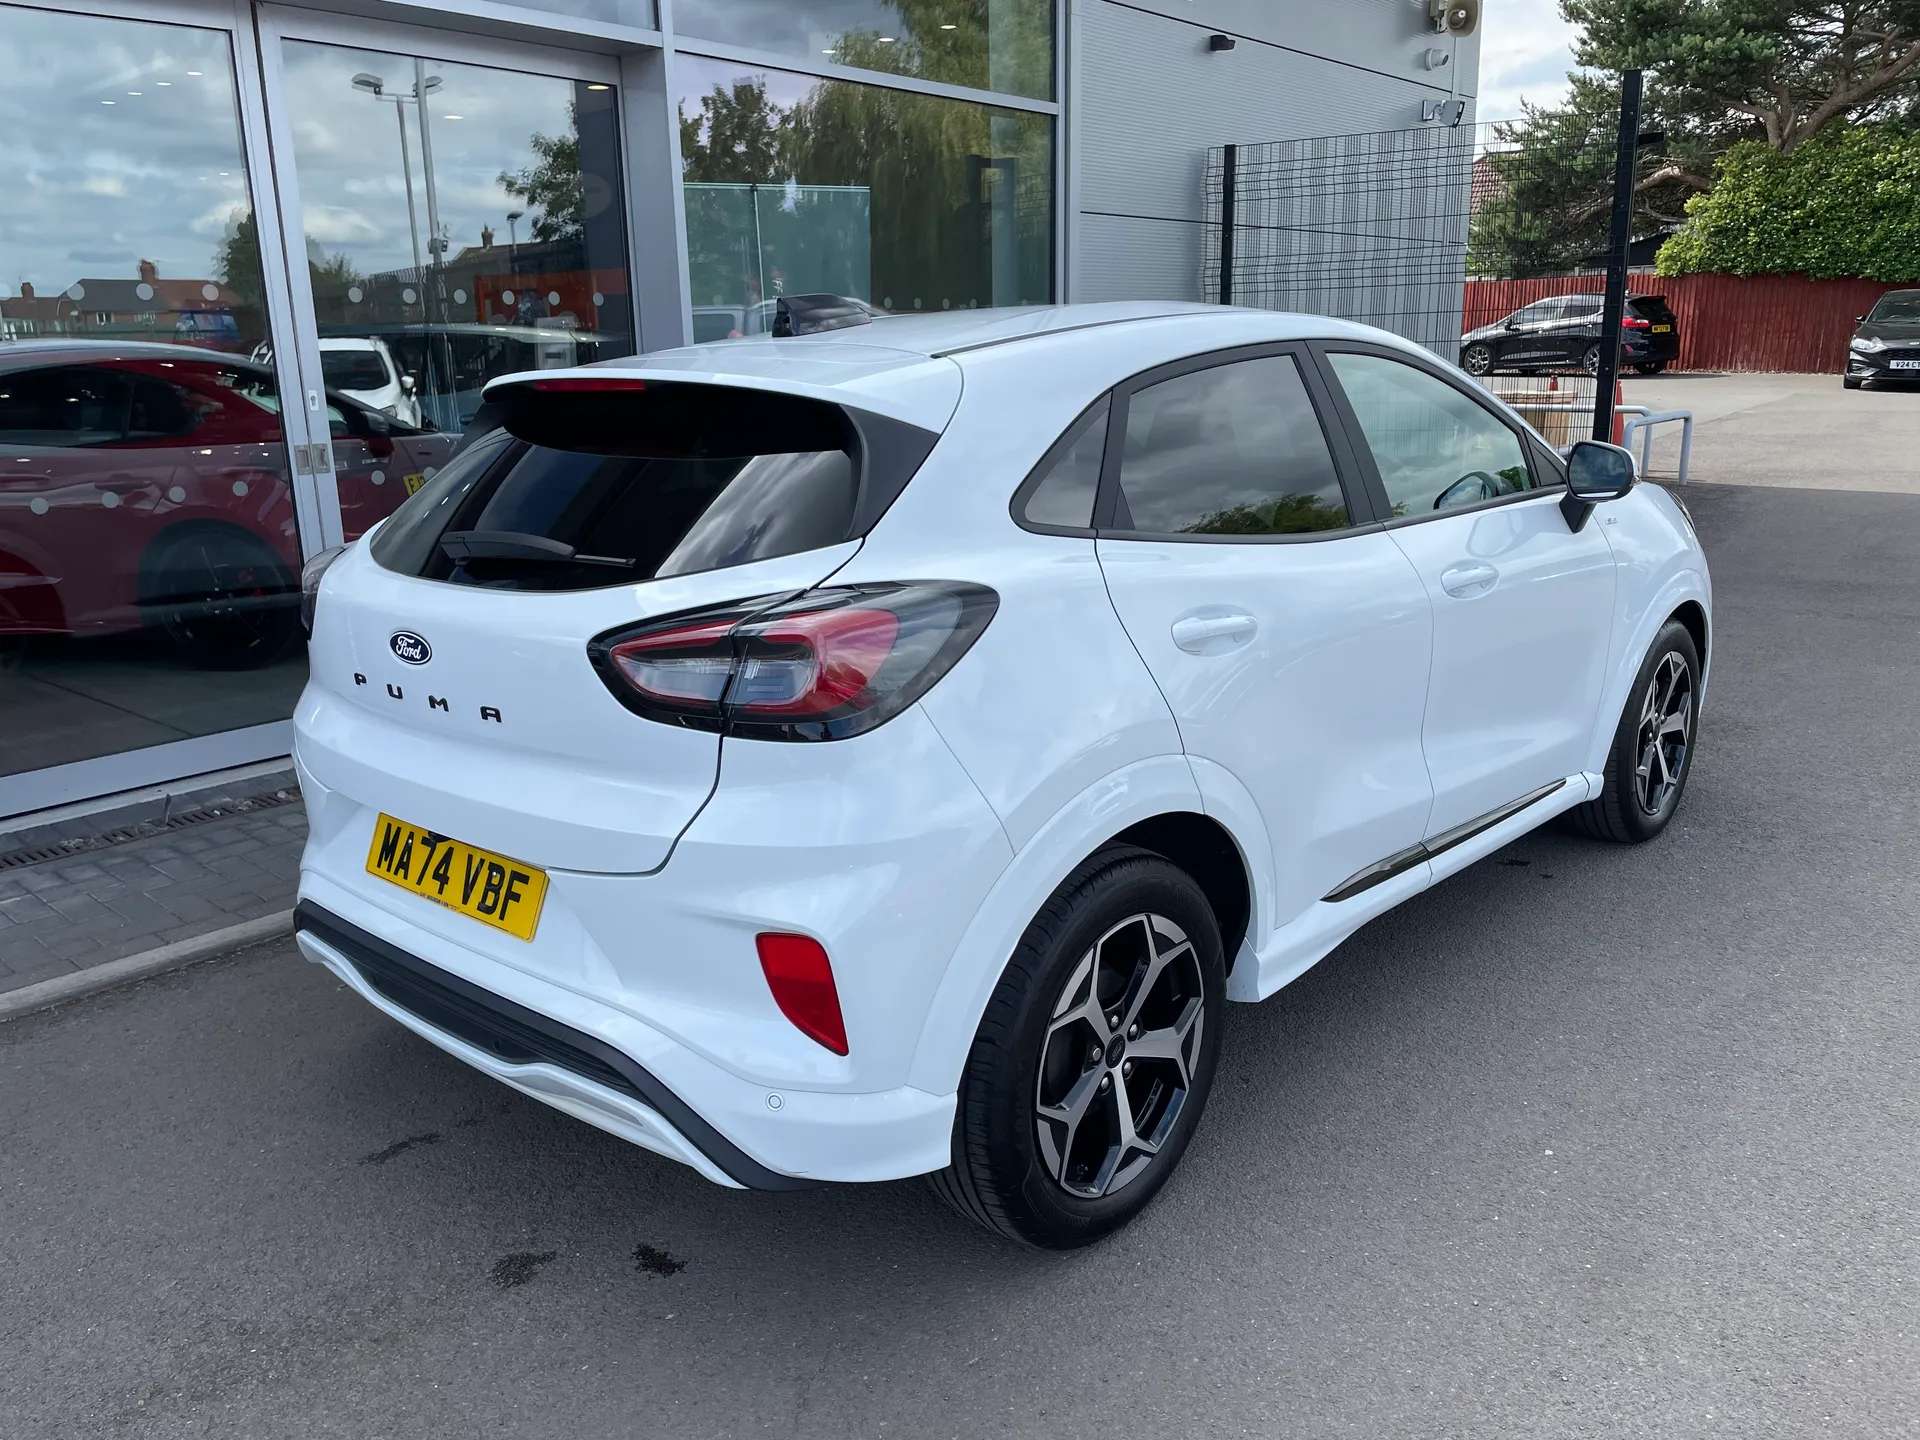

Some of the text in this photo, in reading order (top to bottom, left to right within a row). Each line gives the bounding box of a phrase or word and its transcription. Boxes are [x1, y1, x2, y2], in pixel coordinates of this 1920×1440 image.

[396, 635, 422, 660] Ford
[354, 672, 502, 723] PUMA
[376, 822, 530, 922] MA74 VBF
